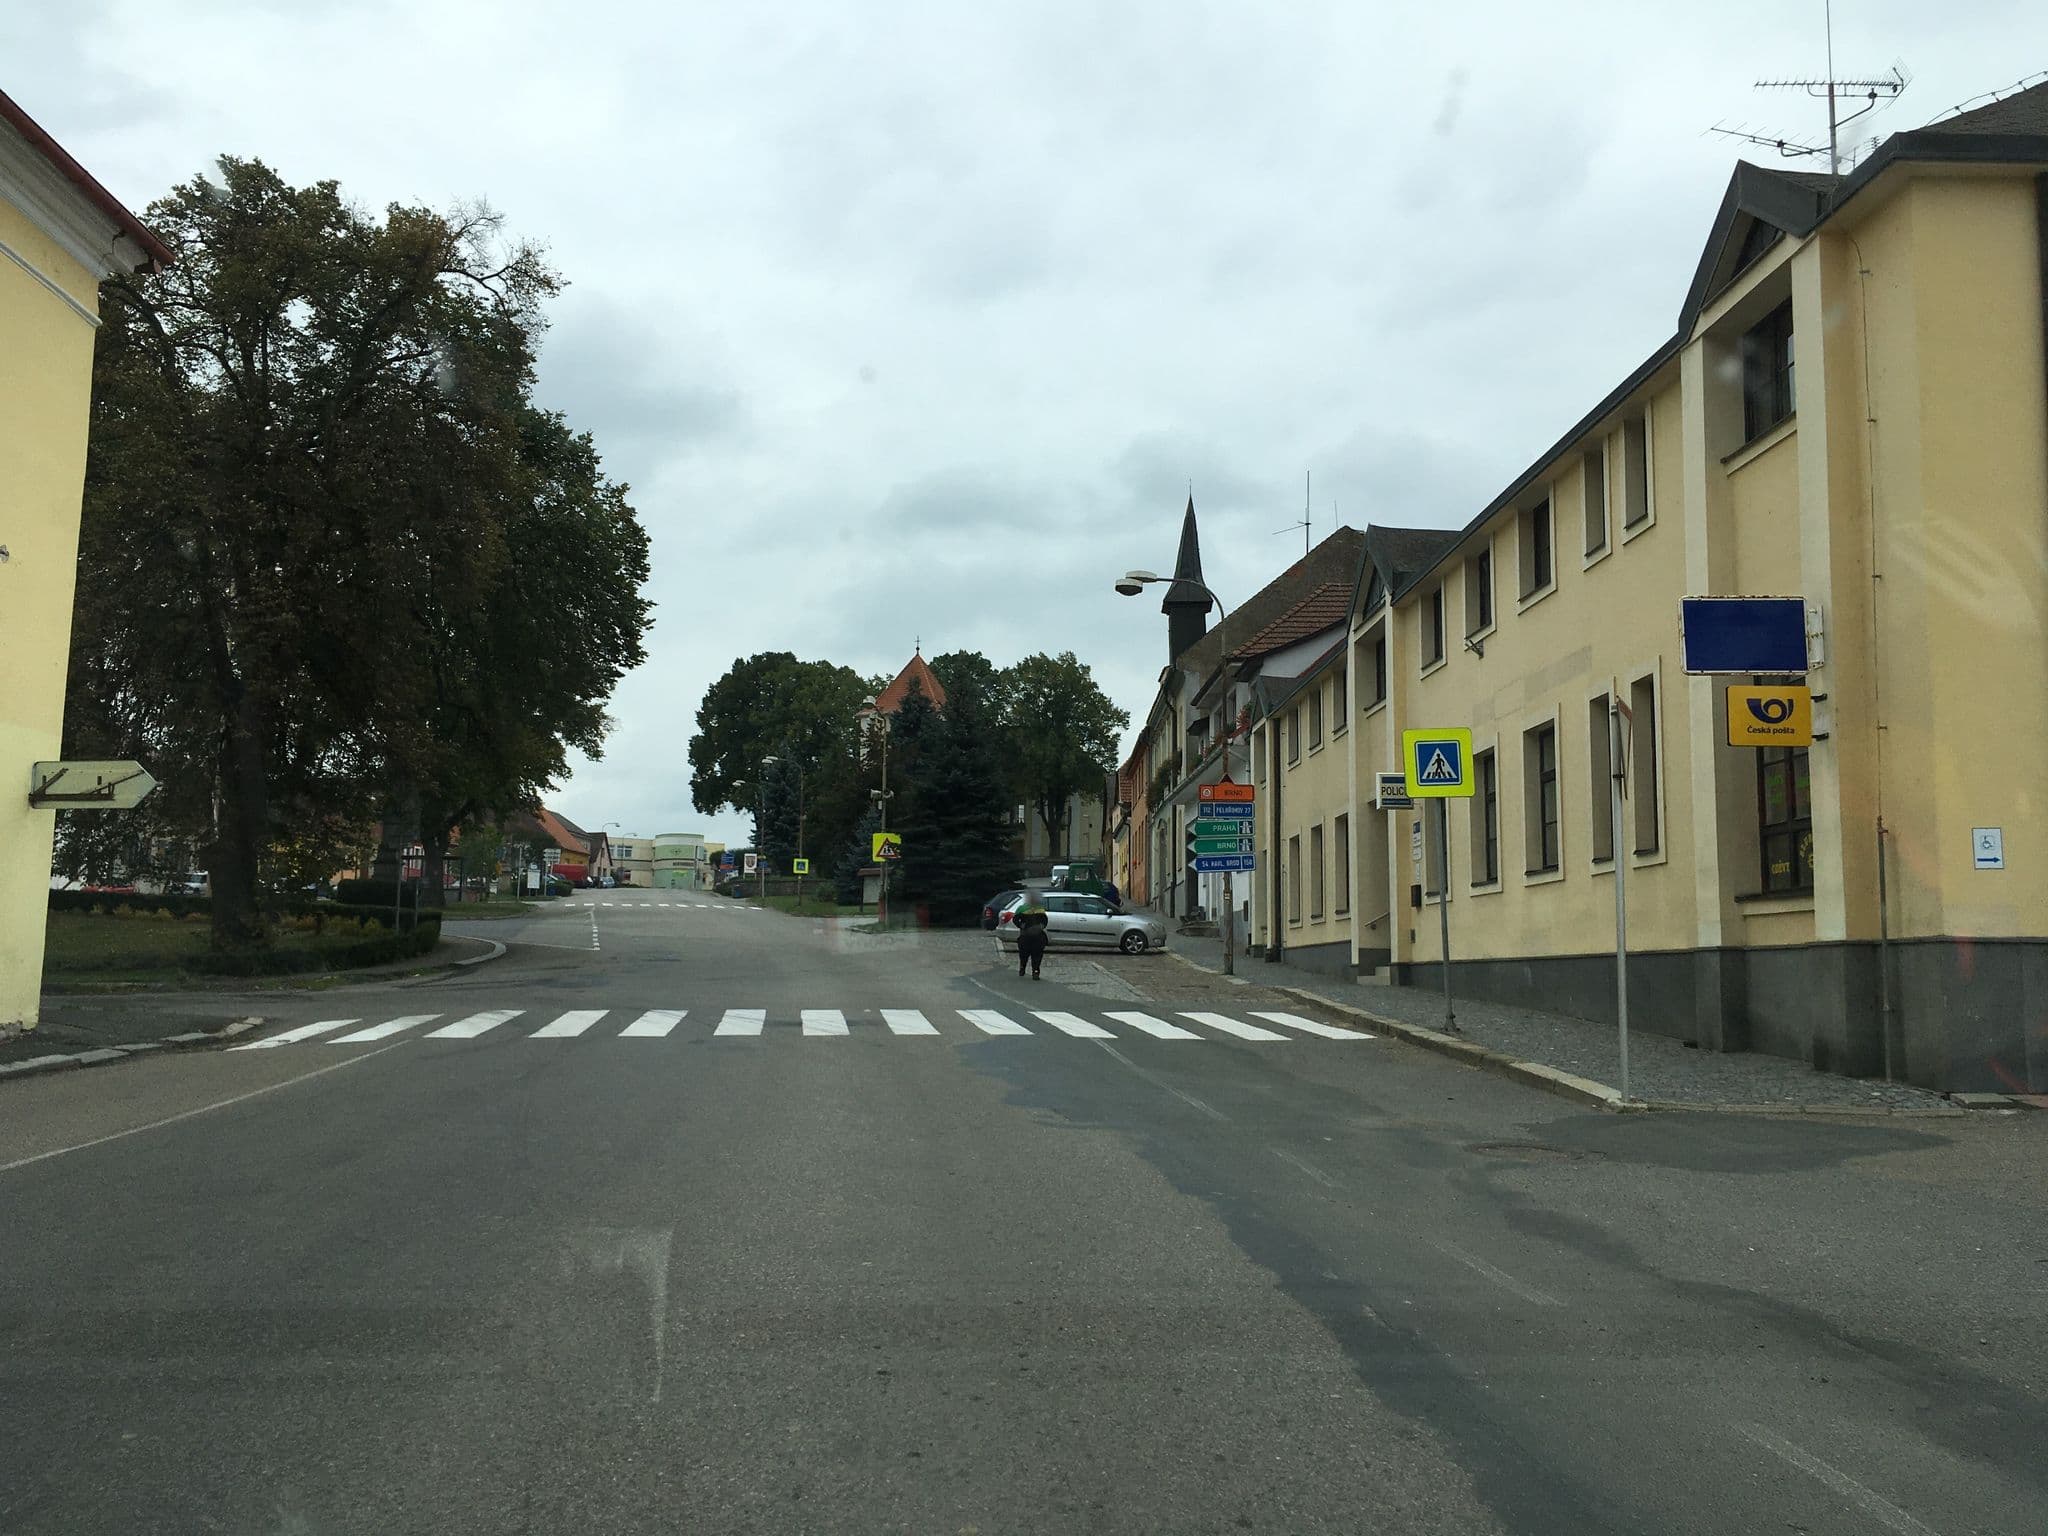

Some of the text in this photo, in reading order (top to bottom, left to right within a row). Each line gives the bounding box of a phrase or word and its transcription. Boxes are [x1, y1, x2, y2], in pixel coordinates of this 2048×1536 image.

[1747, 725, 1795, 735] Česká pošta
[1381, 786, 1404, 796] POLIC
